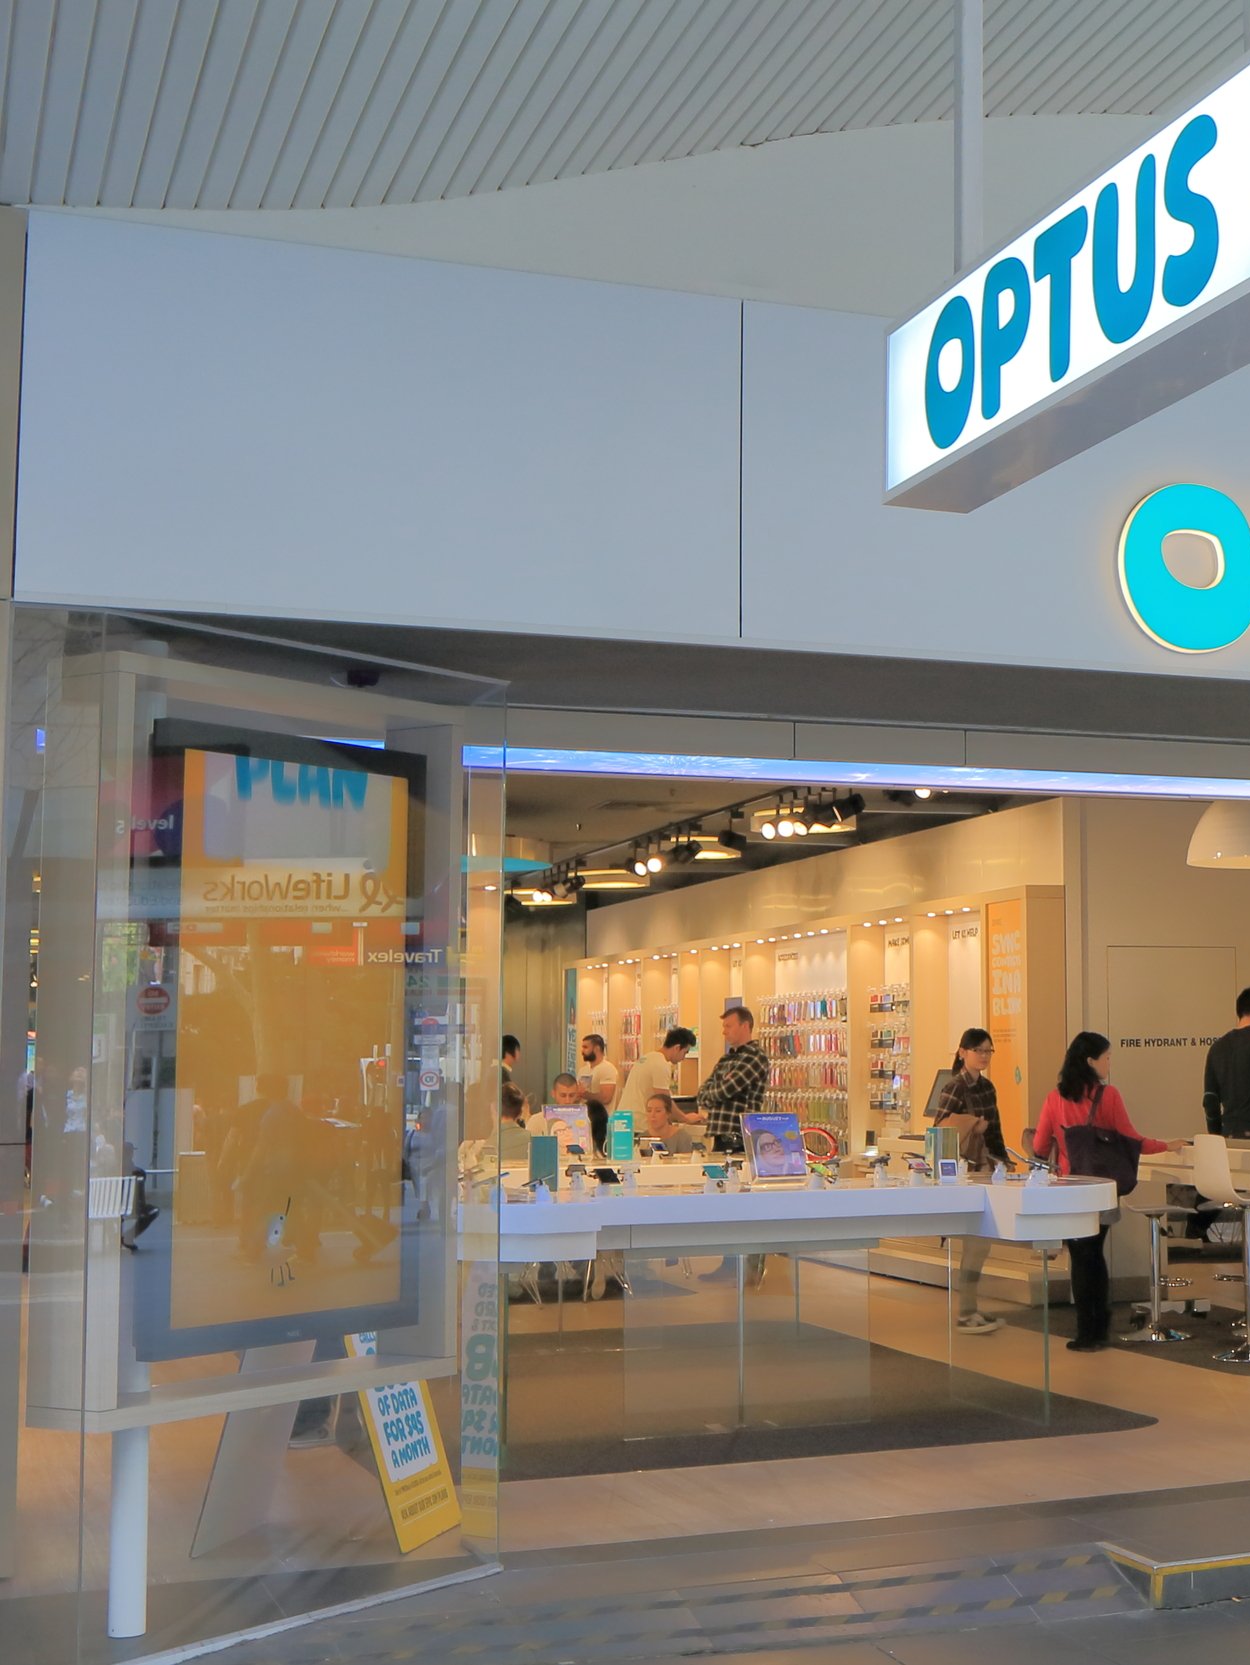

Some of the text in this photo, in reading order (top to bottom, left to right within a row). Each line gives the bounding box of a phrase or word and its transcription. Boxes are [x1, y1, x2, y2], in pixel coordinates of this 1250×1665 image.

[925, 114, 1219, 449] OPTUS
[1120, 1039, 1141, 1048] FIRE
[1144, 1038, 1188, 1047] HYDRANT
[1190, 1037, 1196, 1046] &
[377, 1387, 418, 1417] OF DATA
[383, 1411, 424, 1446] FOR $95
[391, 1440, 431, 1469] A MONTH
